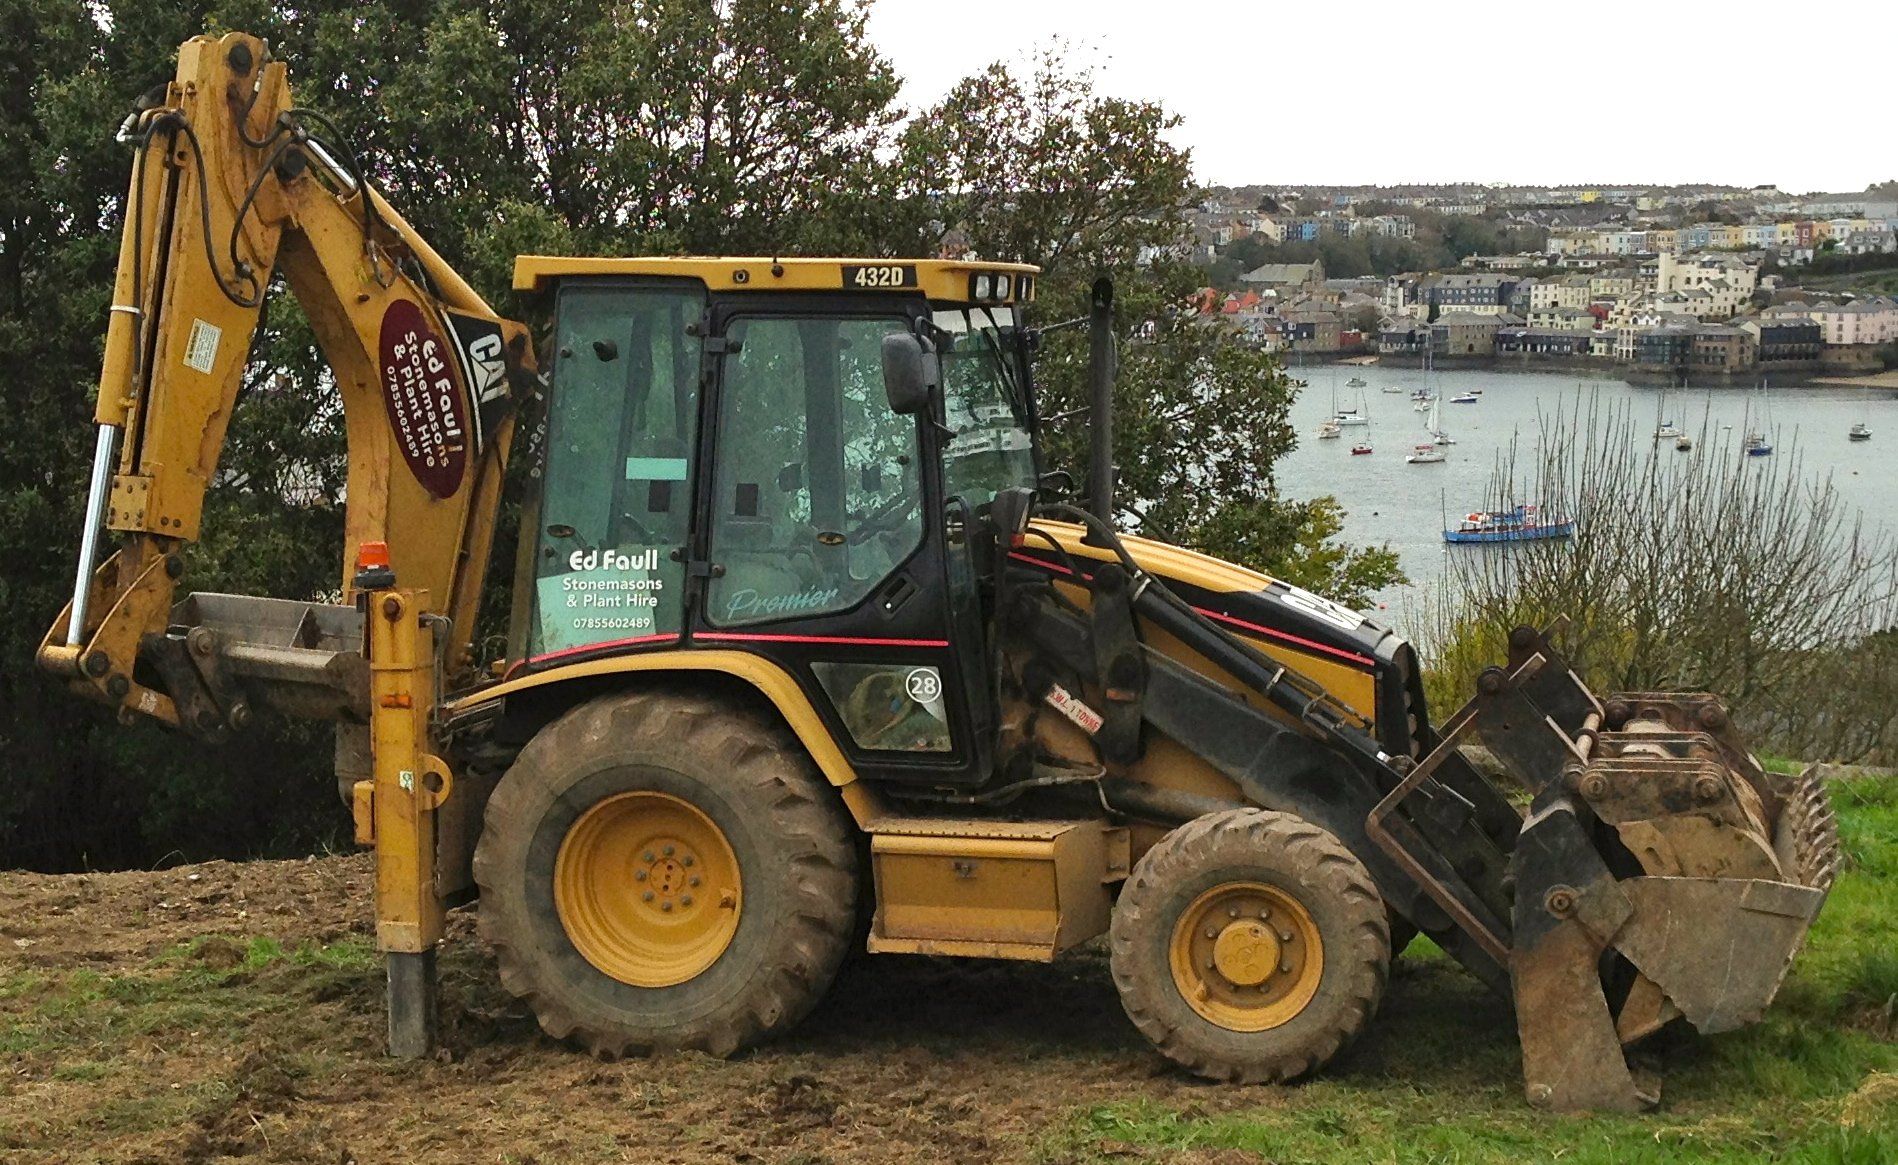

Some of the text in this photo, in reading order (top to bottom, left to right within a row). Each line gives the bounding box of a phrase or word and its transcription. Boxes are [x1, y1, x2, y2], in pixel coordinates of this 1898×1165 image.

[855, 266, 904, 287] 432D
[393, 344, 435, 467] & Plant Hire
[404, 330, 449, 468] Stonemasons
[422, 339, 463, 452] Ed Faull
[386, 365, 420, 458] 07855602489
[569, 549, 658, 571] Ed Faull
[562, 577, 663, 591] Stonemasons
[566, 594, 658, 607] & Plant Hire
[726, 585, 839, 620] Premier
[573, 617, 651, 629] 07855602489
[911, 676, 936, 695] 28
